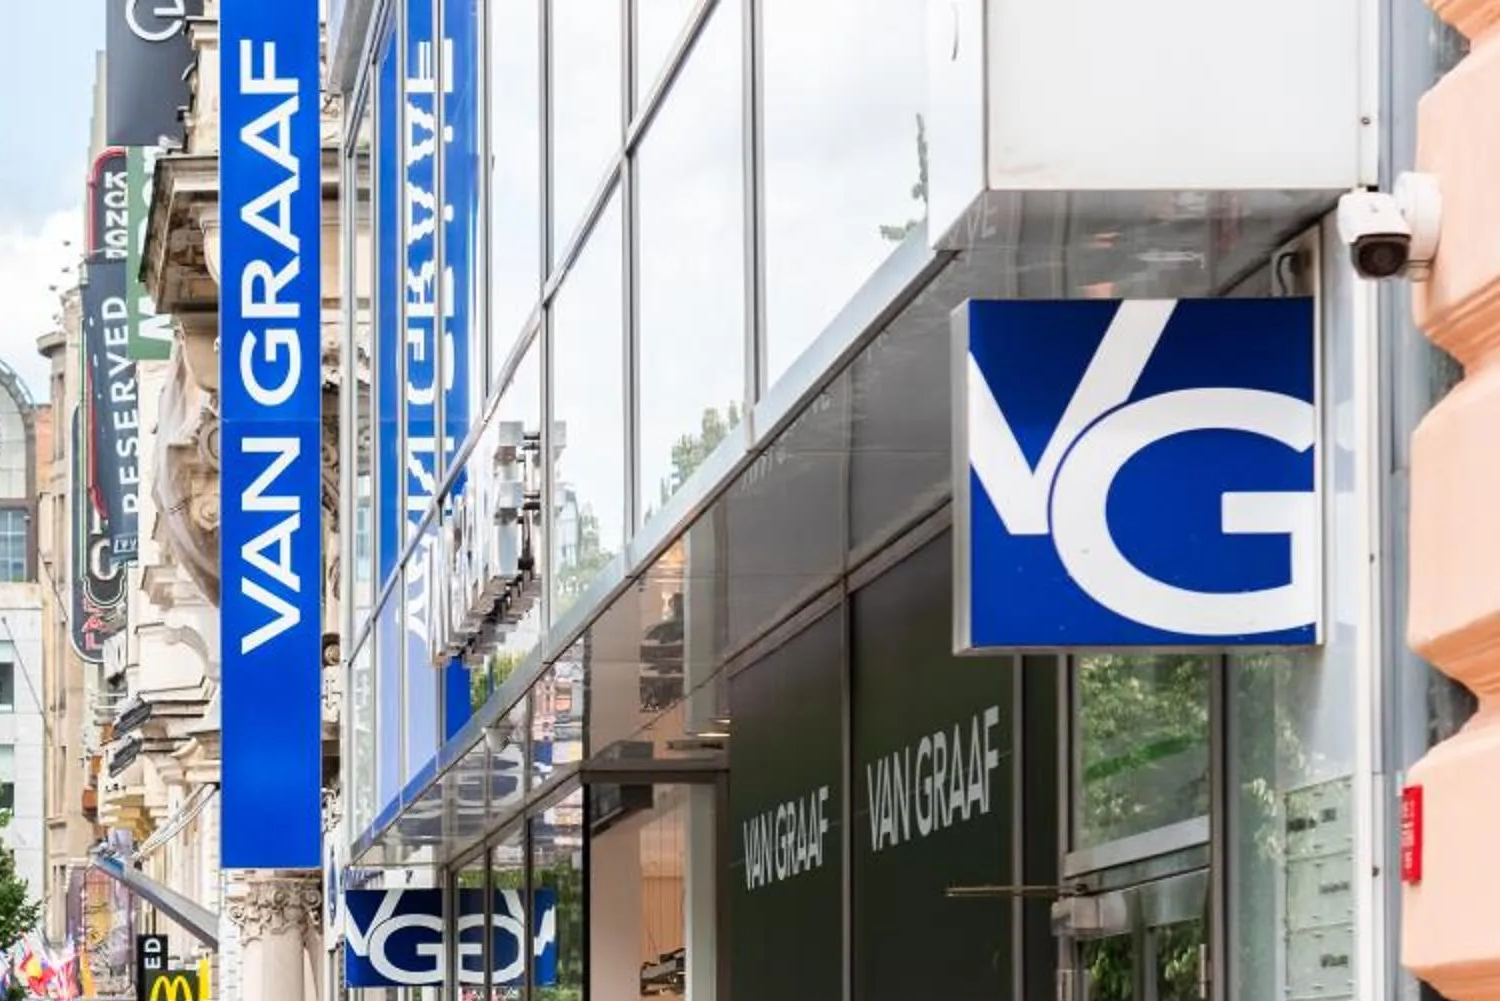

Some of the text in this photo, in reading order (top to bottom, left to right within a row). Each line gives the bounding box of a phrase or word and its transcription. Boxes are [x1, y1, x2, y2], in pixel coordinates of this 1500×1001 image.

[101, 296, 138, 516] RESERVED
[240, 39, 302, 655] VAN GRAAF
[969, 300, 1317, 636] VG
[743, 785, 829, 890] VAN GRAAF
[867, 705, 999, 851] VAN GRAAF
